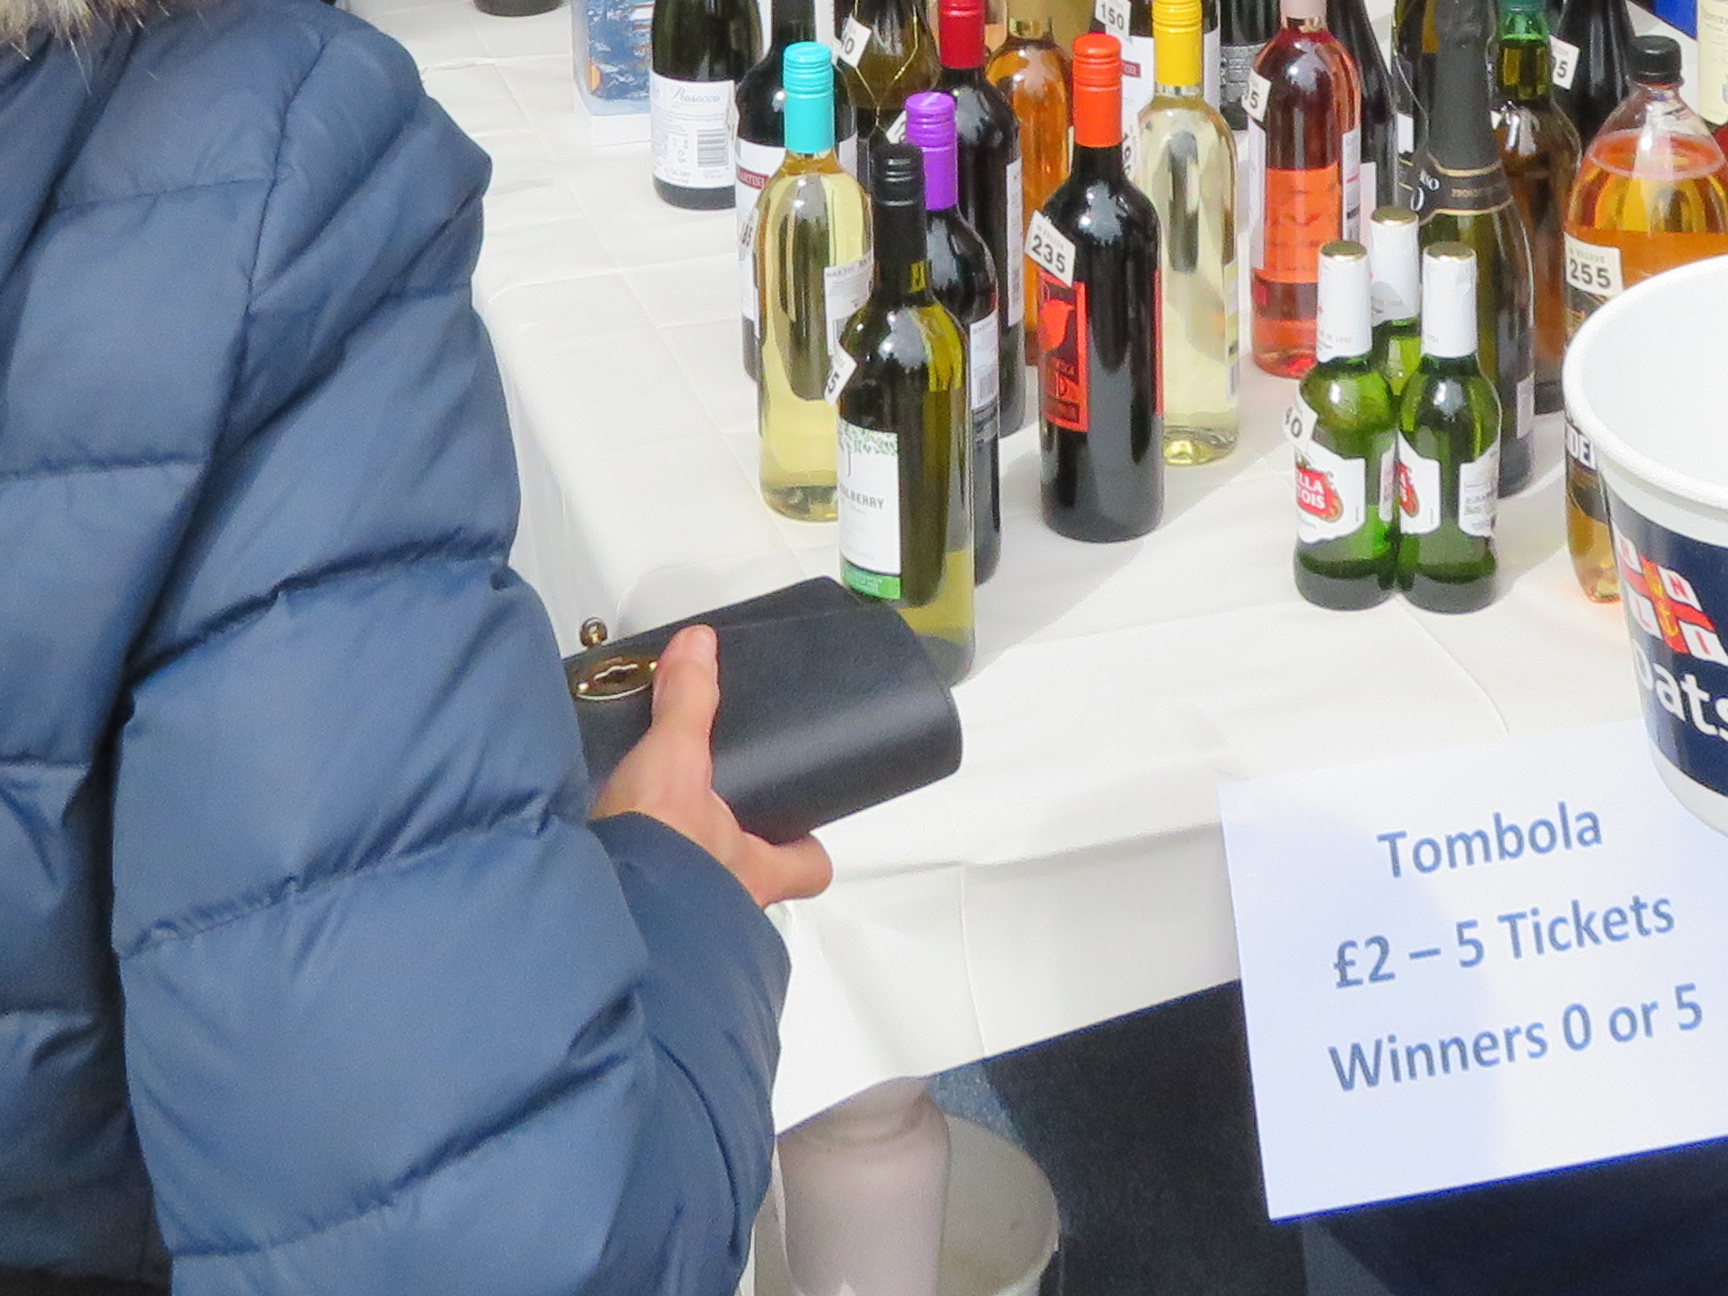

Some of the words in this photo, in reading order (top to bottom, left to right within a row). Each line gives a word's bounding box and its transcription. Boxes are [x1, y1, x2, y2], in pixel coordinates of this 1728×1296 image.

[1100, 2, 1125, 31] 150
[672, 87, 721, 103] Prosecco
[1031, 234, 1067, 274] 235
[1569, 258, 1612, 289] 255
[1377, 801, 1603, 878] Tombola
[1333, 935, 1396, 989] £2
[1456, 920, 1485, 969] 5
[1497, 895, 1675, 960] Tickets
[1328, 1021, 1548, 1093] Winners
[1561, 1003, 1591, 1052] 0
[1609, 999, 1659, 1045] or
[1675, 982, 1703, 1033] 5
